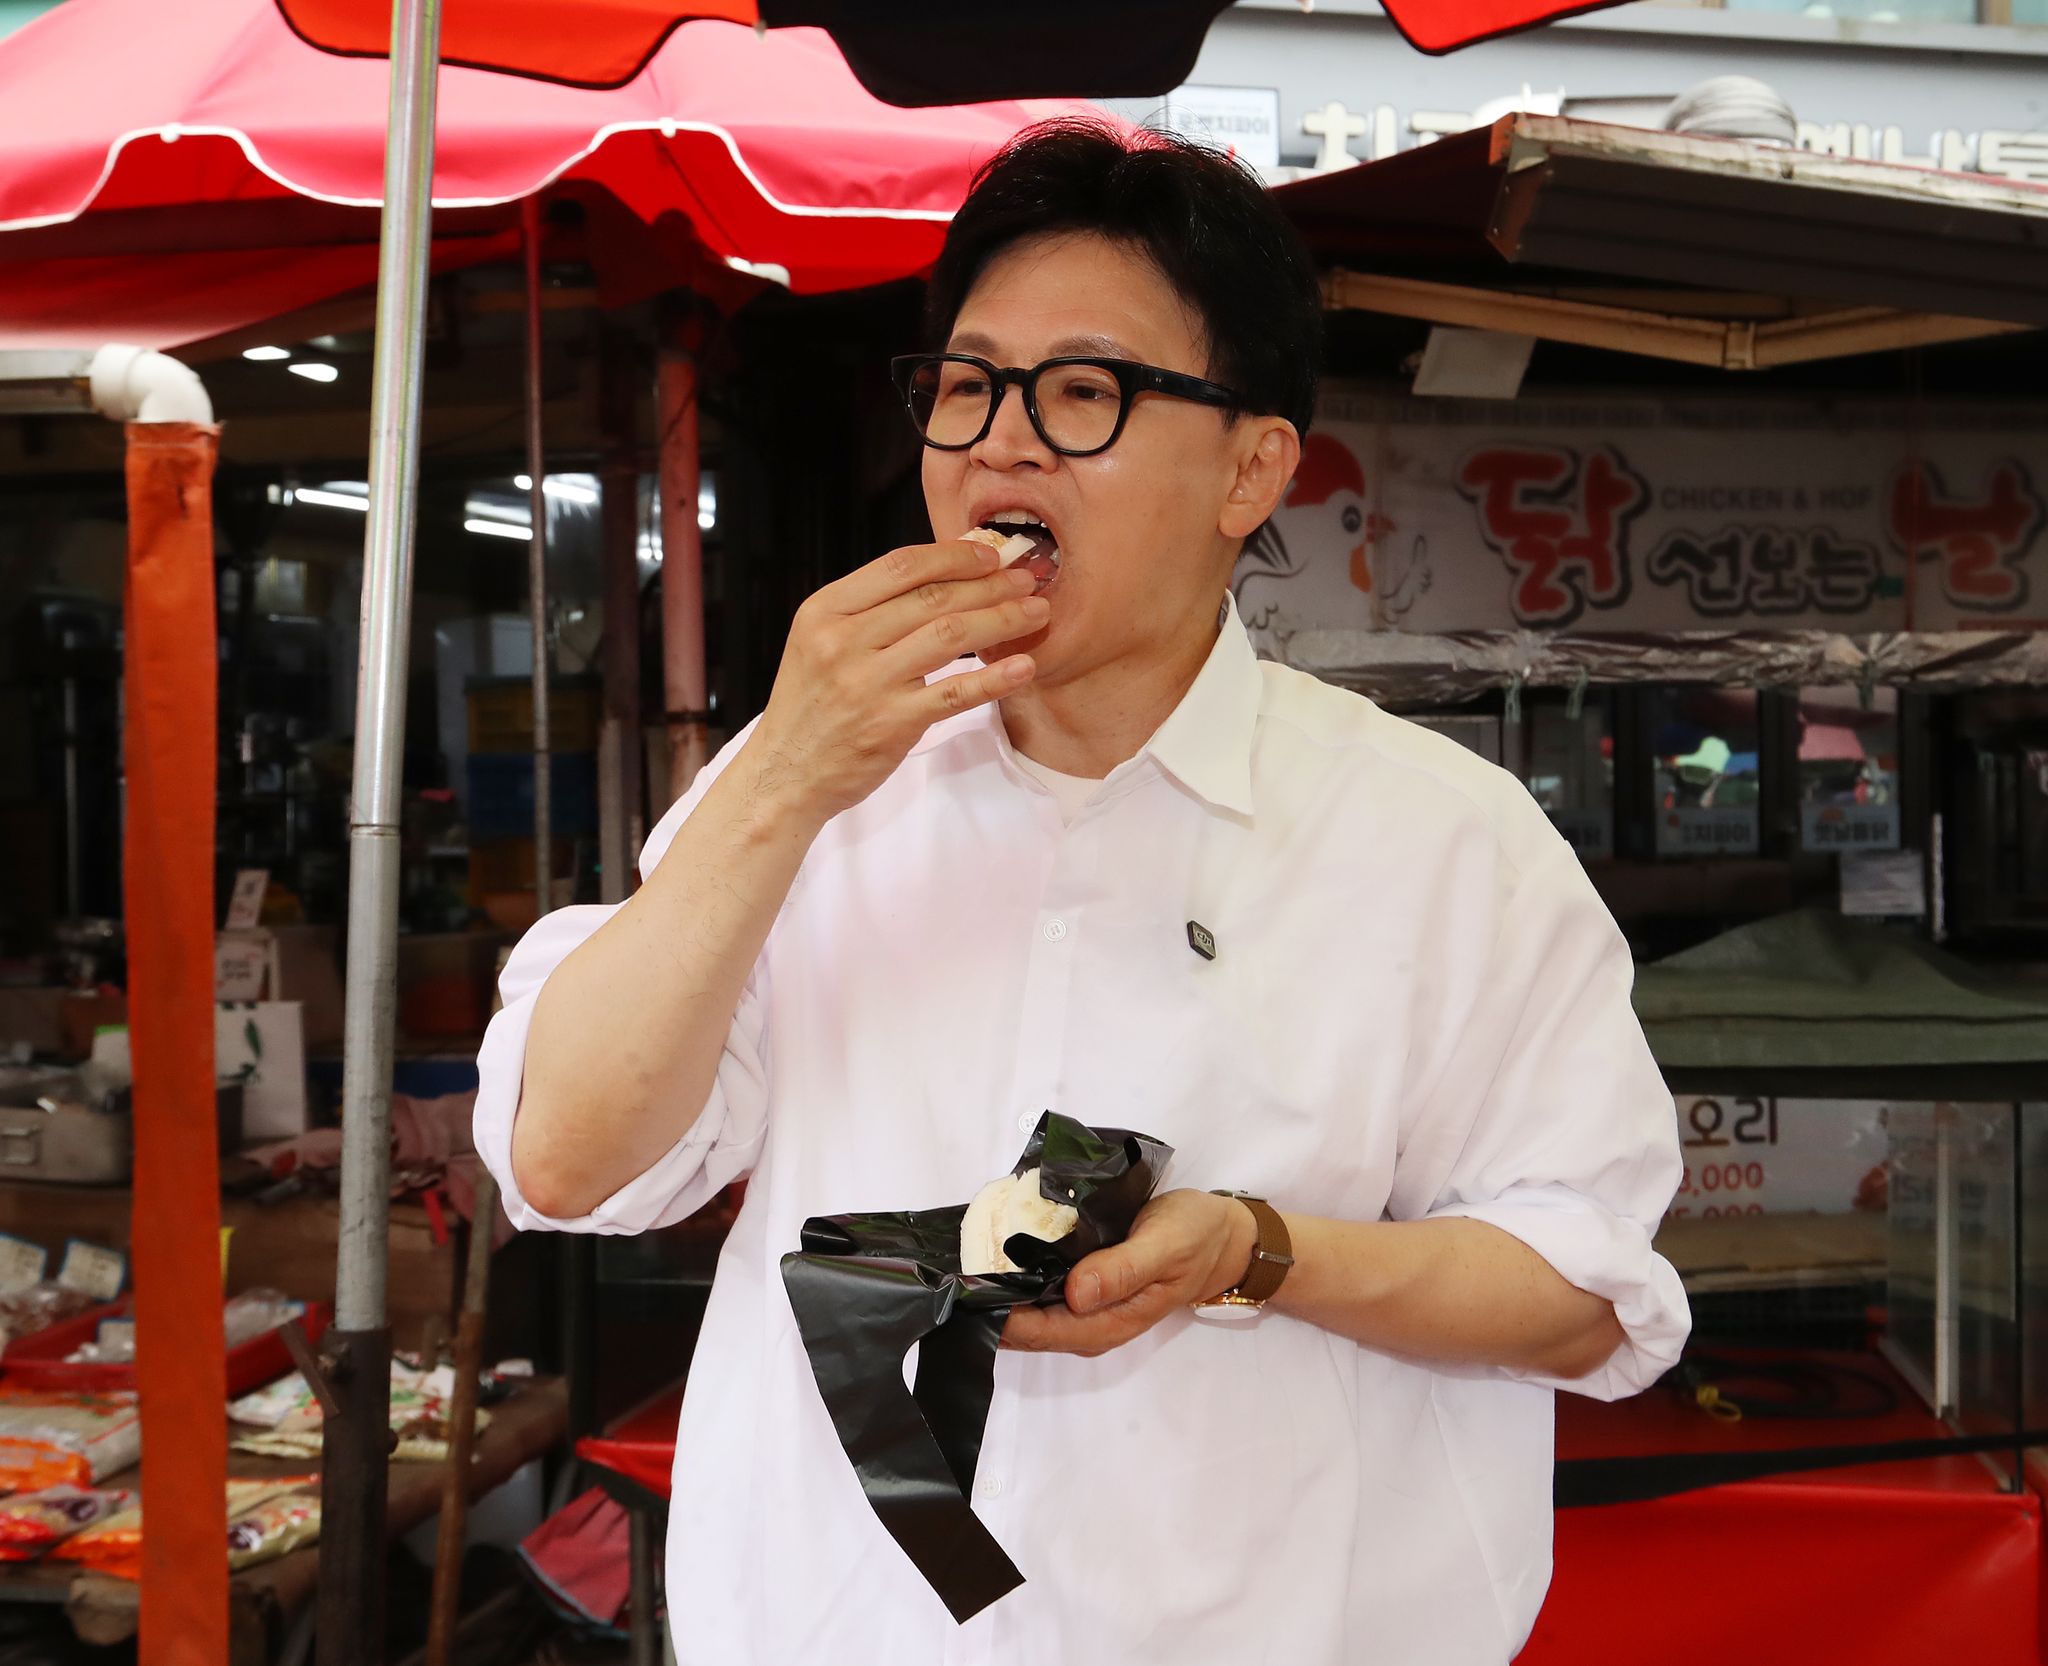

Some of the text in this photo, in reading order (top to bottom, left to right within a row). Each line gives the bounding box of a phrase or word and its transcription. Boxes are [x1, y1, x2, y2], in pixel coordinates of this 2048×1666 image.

[1457, 446, 2038, 622] 닭 선보는 날
[1660, 487, 1871, 509] CHICKEN & HOF
